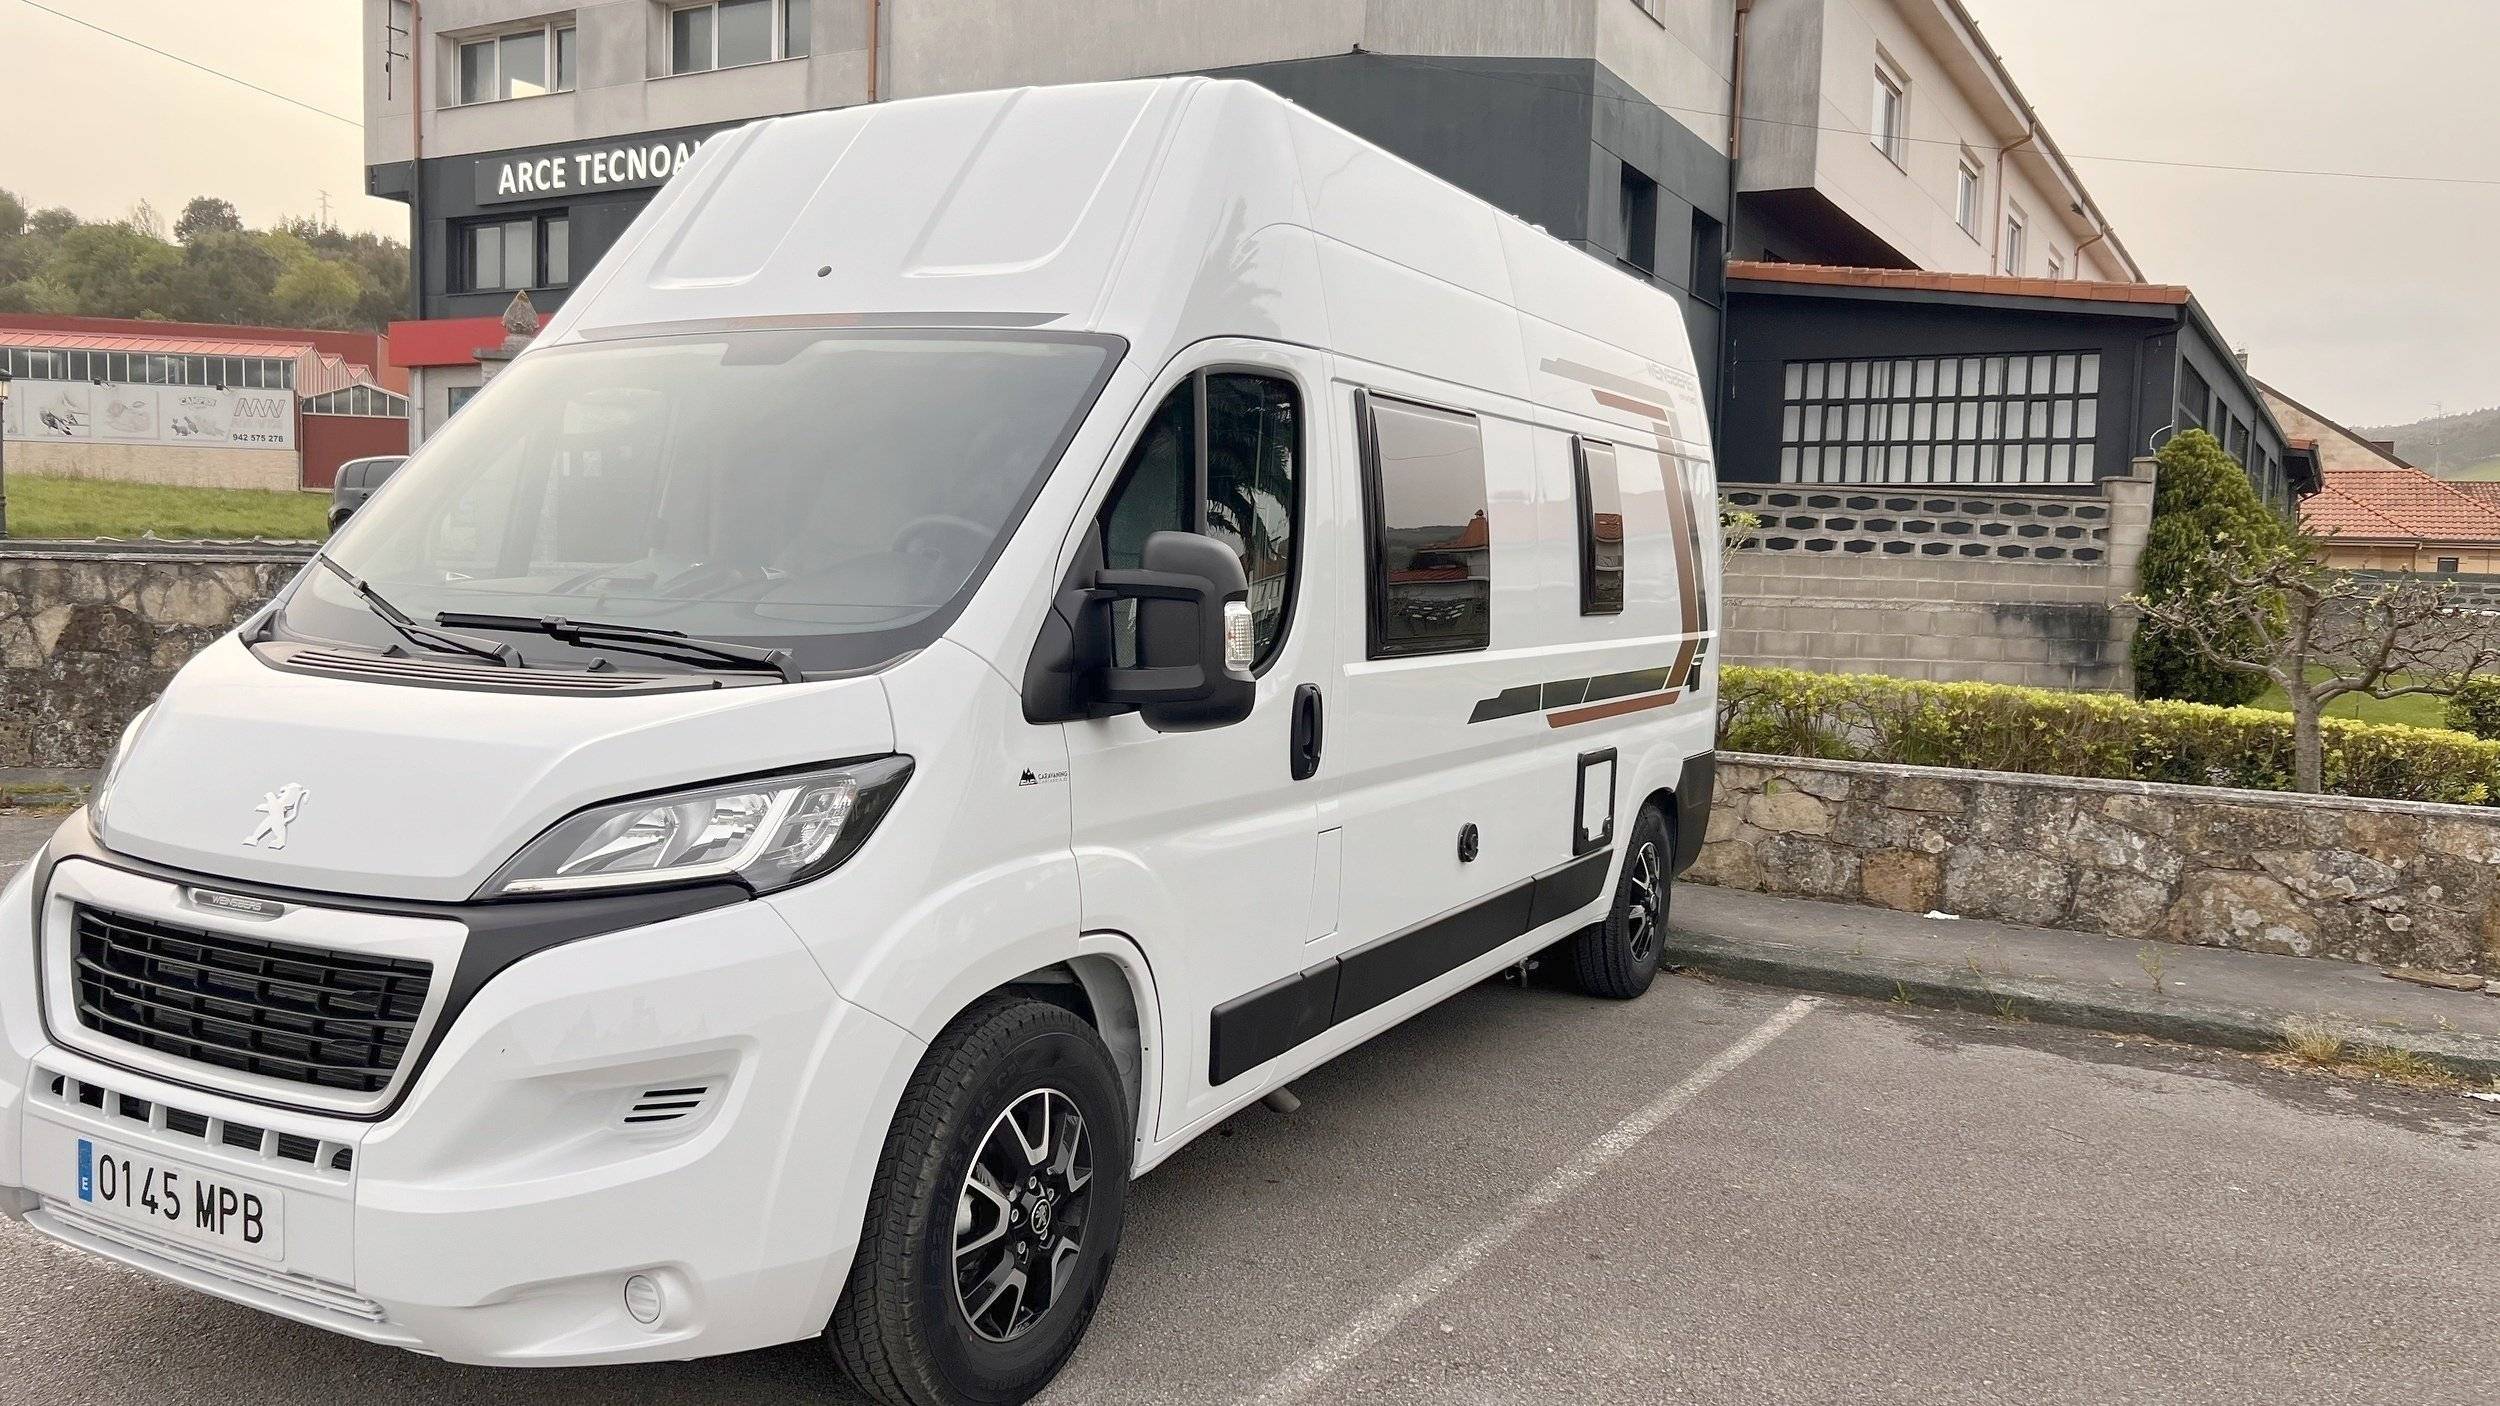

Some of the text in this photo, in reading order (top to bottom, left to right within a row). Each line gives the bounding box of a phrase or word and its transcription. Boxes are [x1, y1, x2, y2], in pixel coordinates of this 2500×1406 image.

[498, 140, 700, 195] ARCE TECNOA
[232, 433, 249, 442] 942
[250, 434, 266, 442] 575
[81, 1177, 89, 1191] E
[99, 1154, 263, 1244] 0145 MPB
